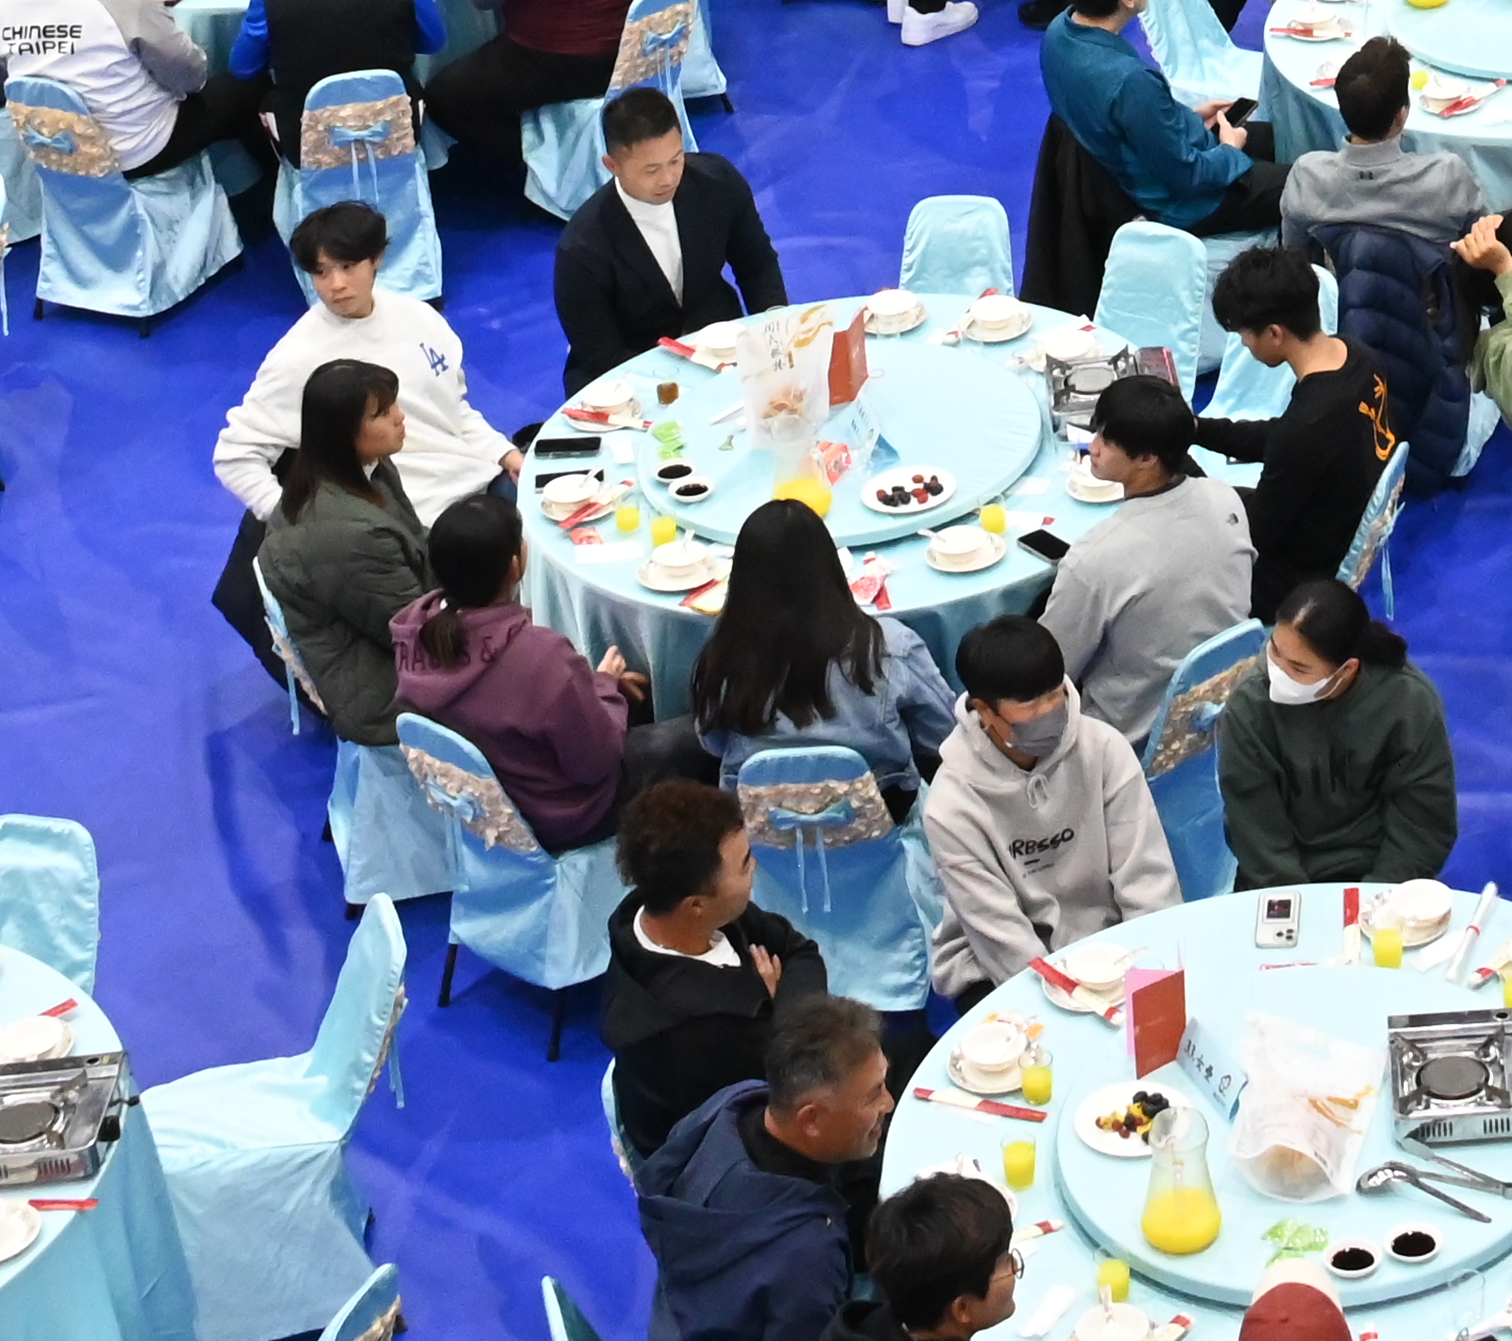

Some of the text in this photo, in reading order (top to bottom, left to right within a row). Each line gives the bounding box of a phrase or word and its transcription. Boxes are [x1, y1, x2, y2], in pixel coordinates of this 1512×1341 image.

[2, 24, 83, 42] CHINESE
[8, 40, 76, 57] TAIPEI
[419, 341, 450, 378] LA
